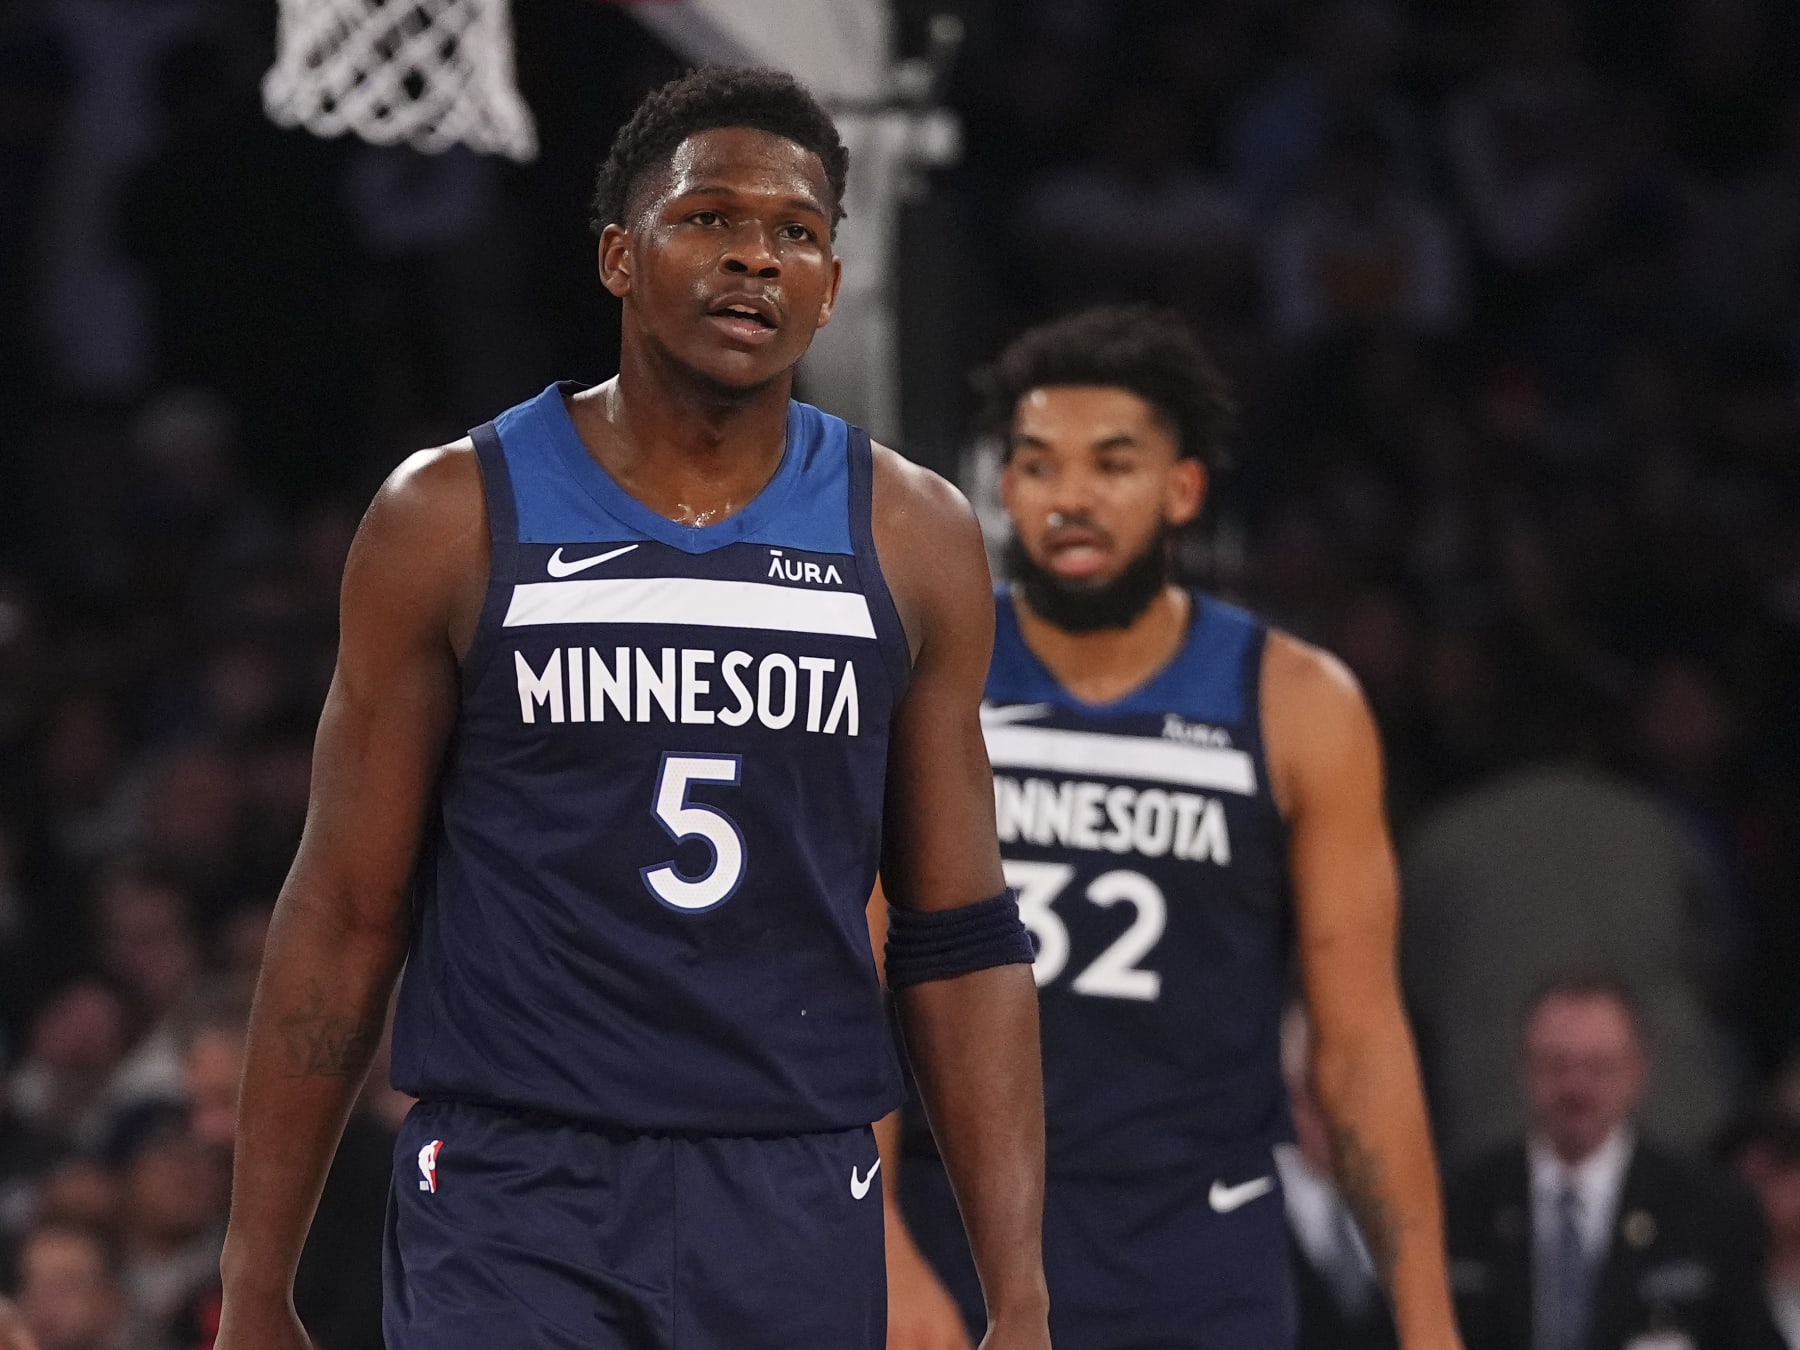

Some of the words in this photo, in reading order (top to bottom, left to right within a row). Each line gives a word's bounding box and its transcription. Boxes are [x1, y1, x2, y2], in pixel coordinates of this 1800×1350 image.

[514, 646, 859, 736] MINNESOTA
[640, 752, 747, 914] 5
[992, 776, 1231, 866] NNESOTA
[1001, 859, 1167, 1001] 32
